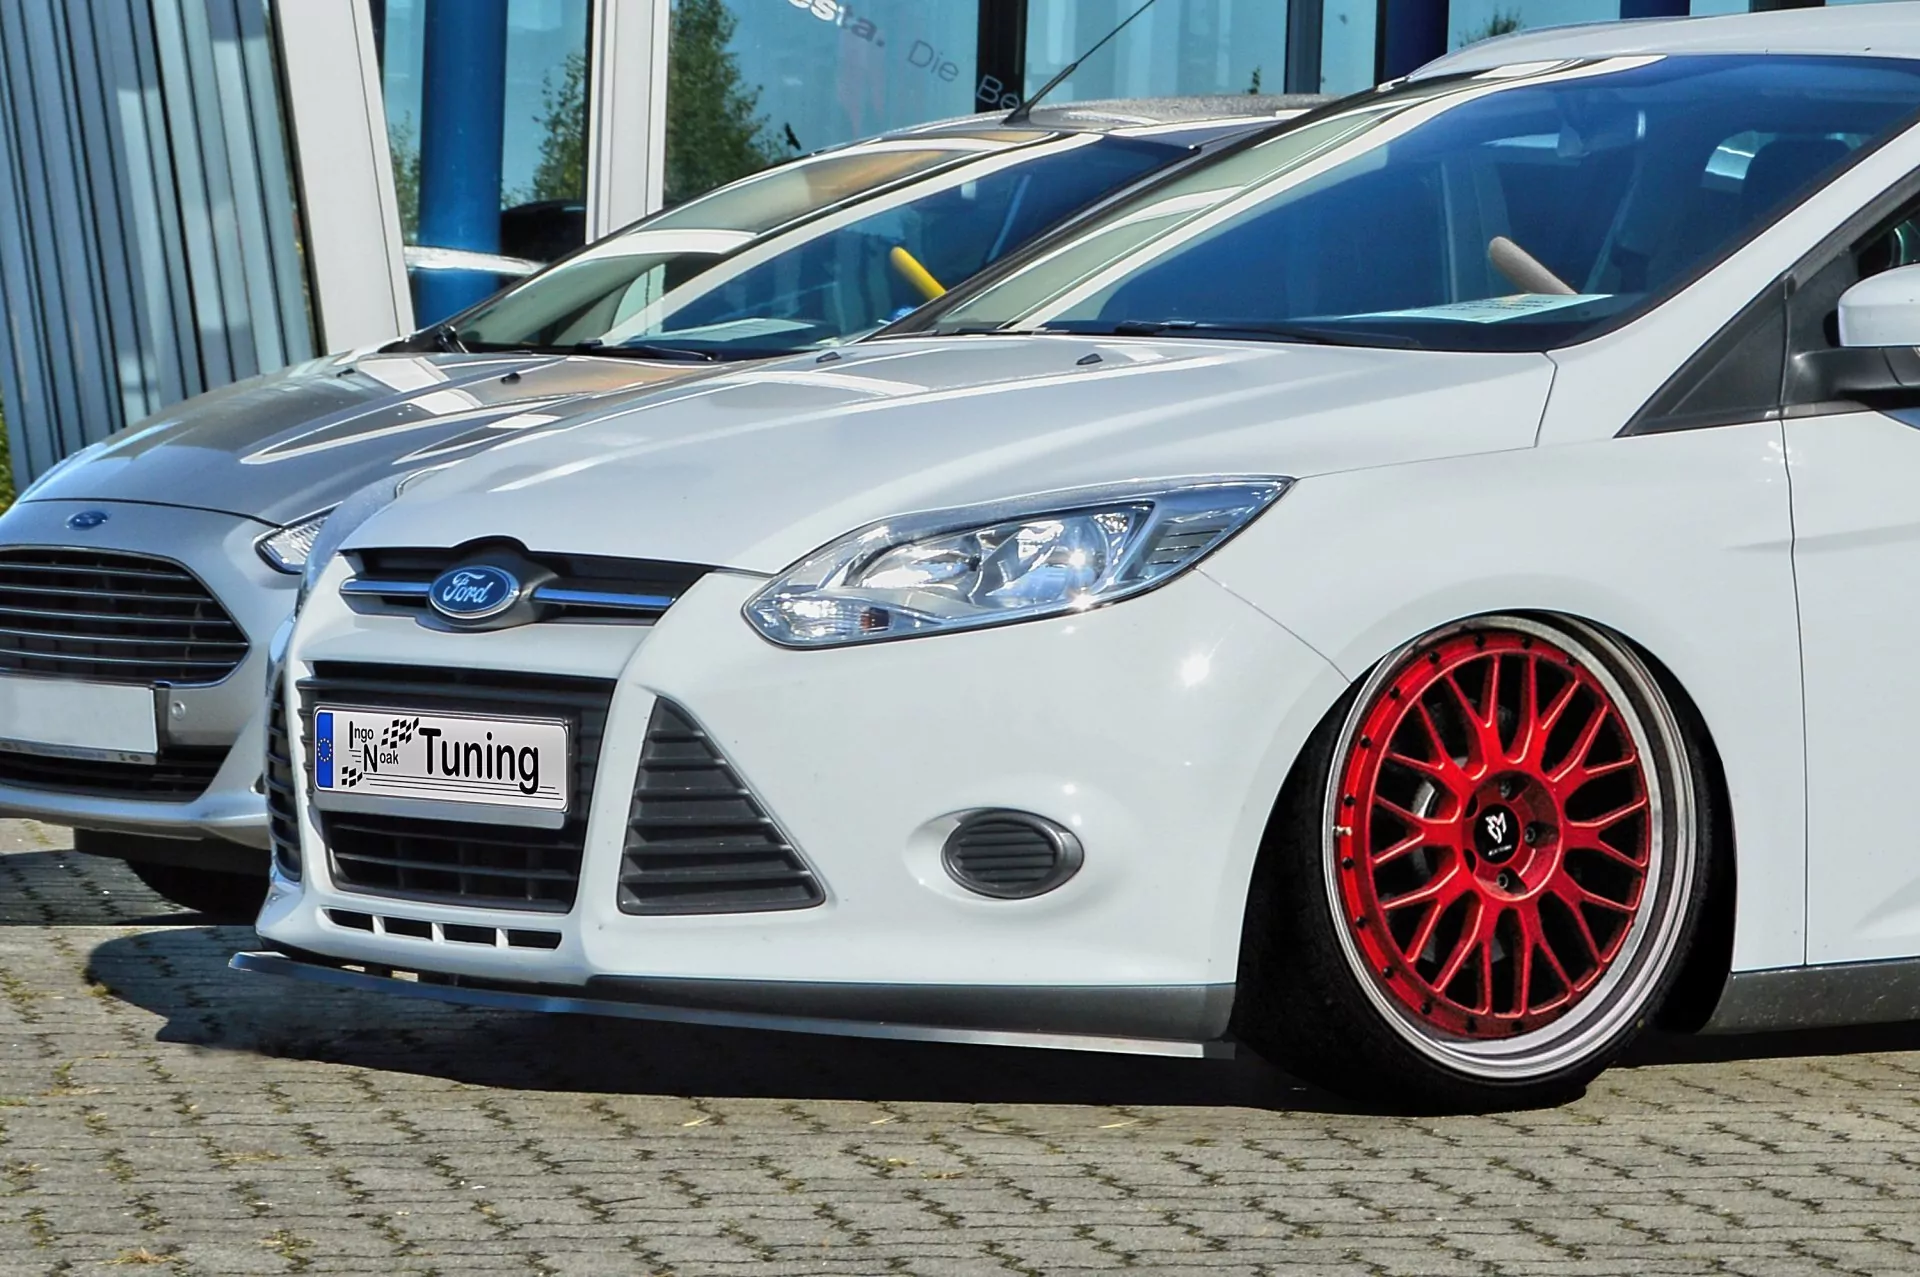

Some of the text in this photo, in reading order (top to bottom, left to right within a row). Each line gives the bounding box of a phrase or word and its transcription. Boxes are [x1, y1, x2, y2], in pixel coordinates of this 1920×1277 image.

[907, 39, 960, 82] Die
[442, 571, 495, 603] Ford
[349, 720, 374, 749] Ingo
[363, 743, 399, 773] Noak
[418, 727, 540, 795] Tuning
